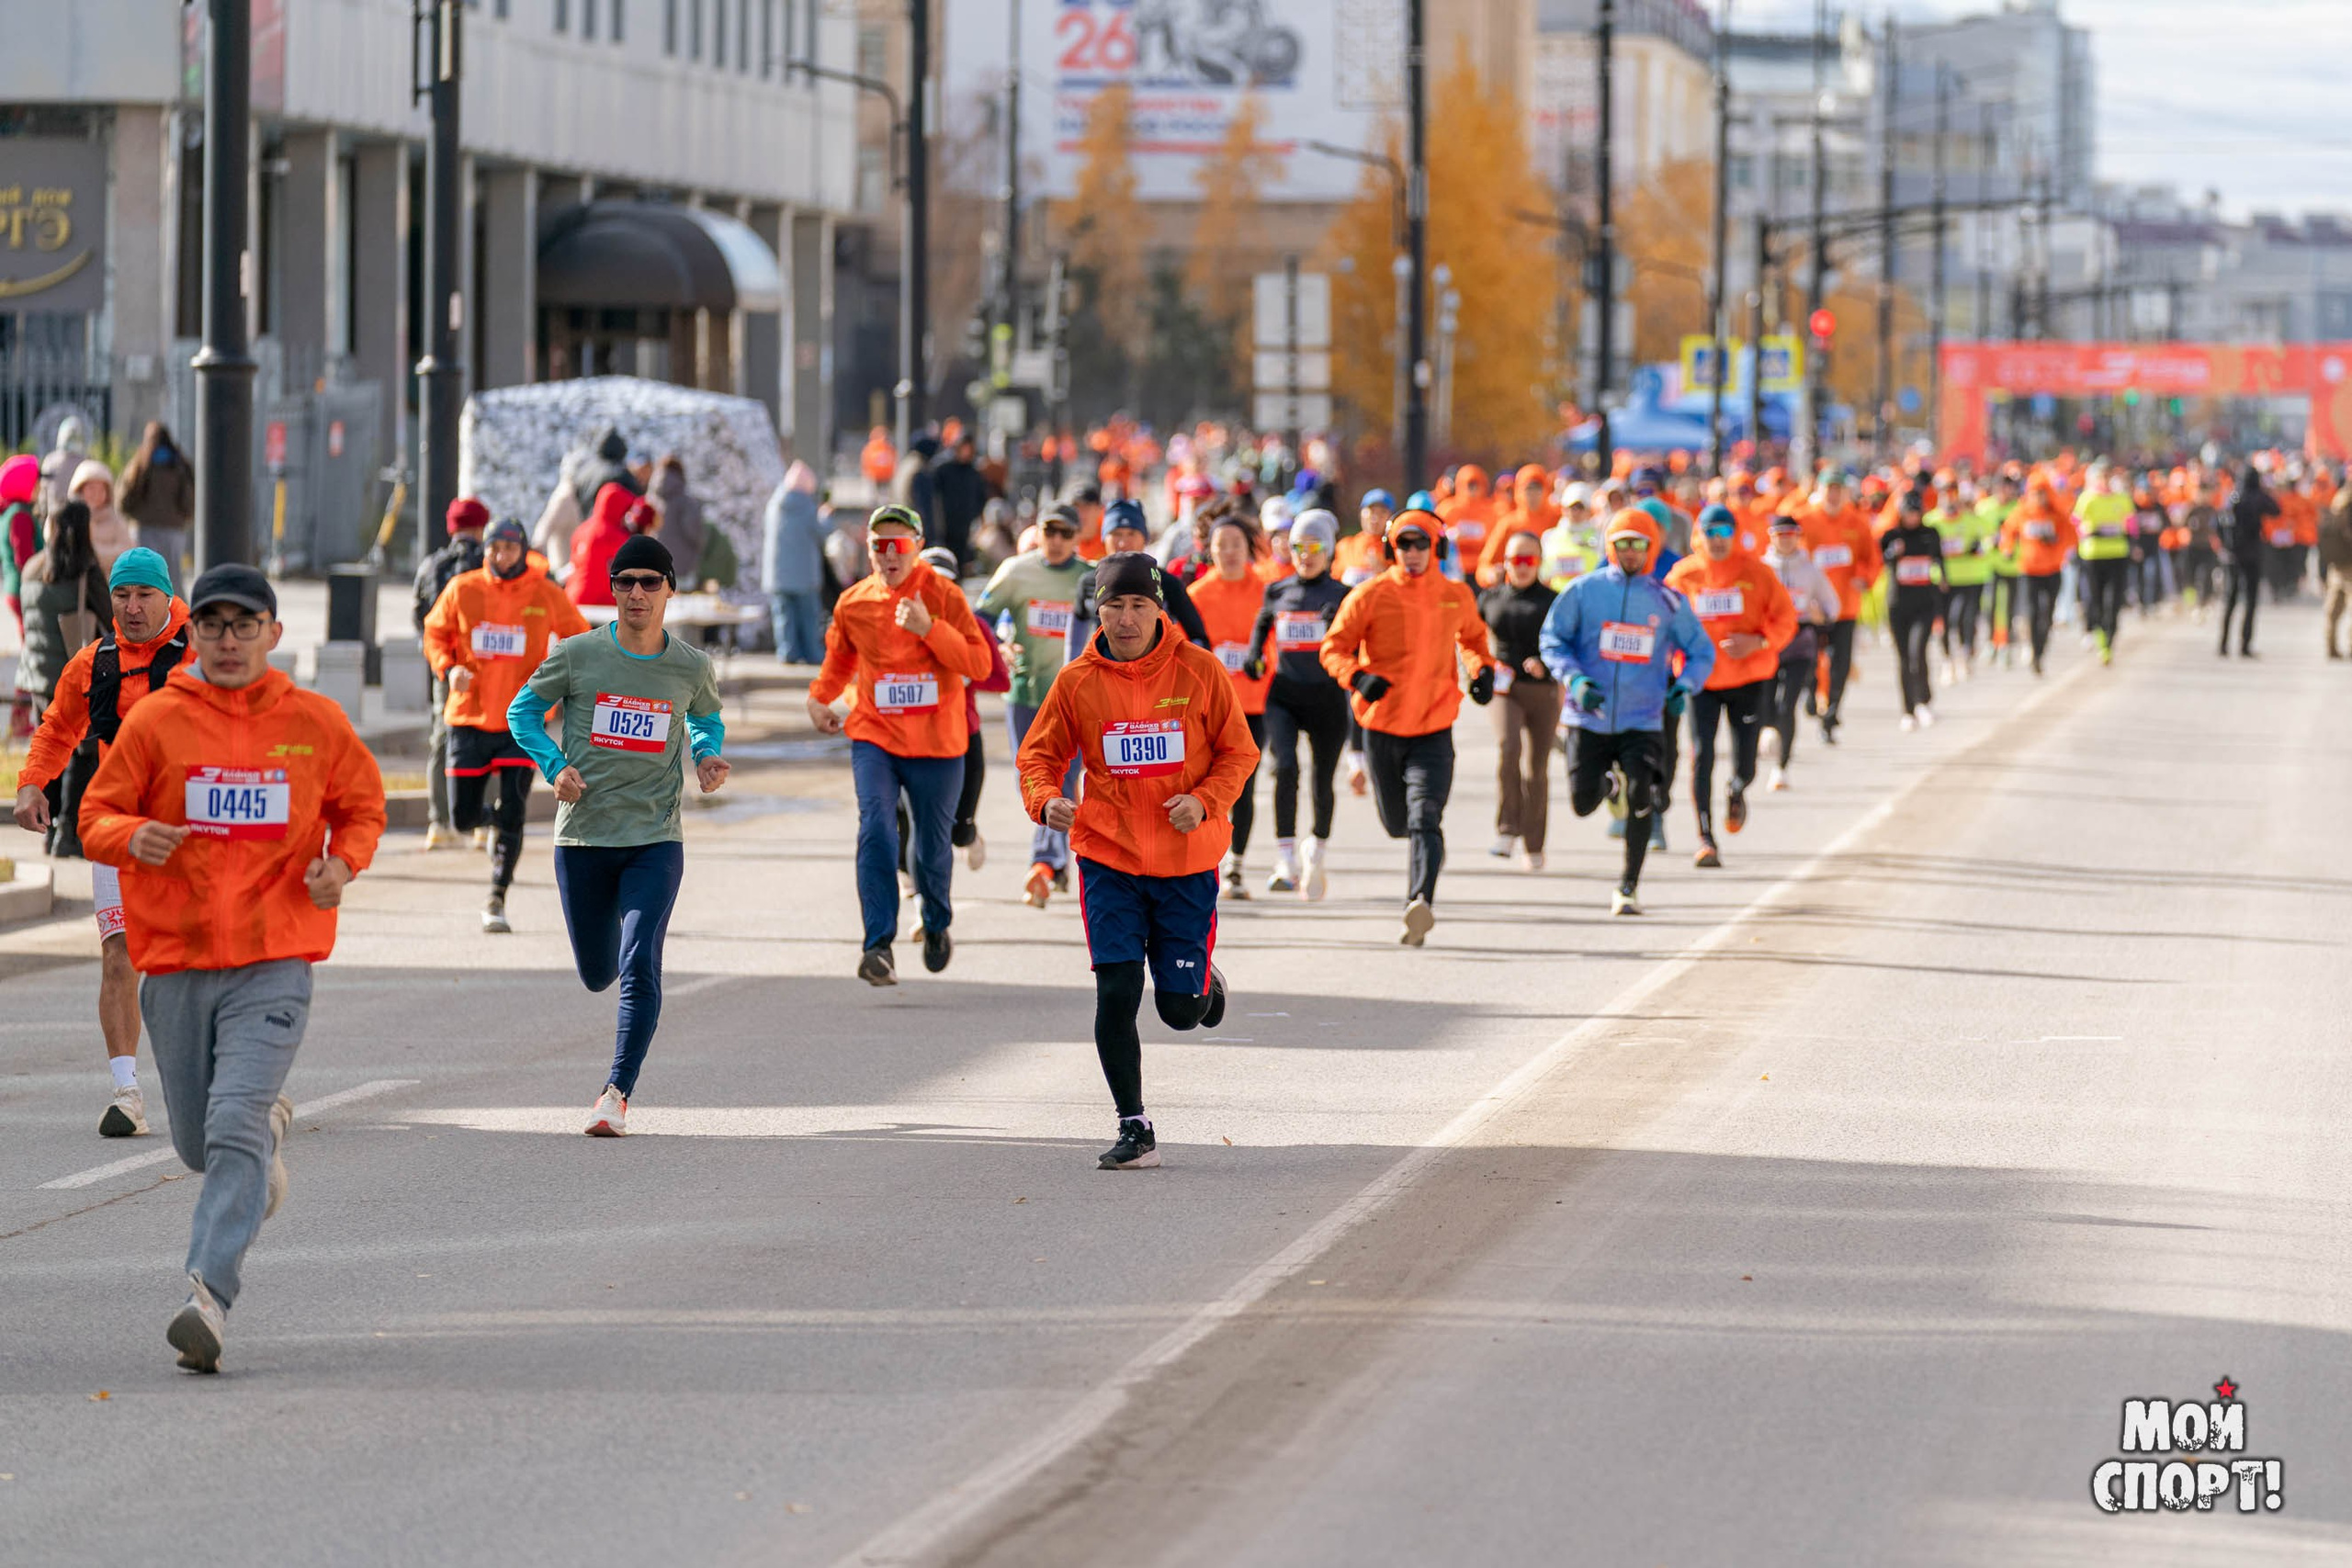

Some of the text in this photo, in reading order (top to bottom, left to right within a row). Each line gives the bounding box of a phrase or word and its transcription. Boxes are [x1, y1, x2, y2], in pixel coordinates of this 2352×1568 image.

[1056, 8, 1136, 71] 26
[888, 684, 923, 705] 0507
[609, 710, 655, 738] 0525
[593, 736, 625, 747] ЯКУТСК
[1120, 736, 1168, 762] 0390
[208, 787, 267, 819] 0445
